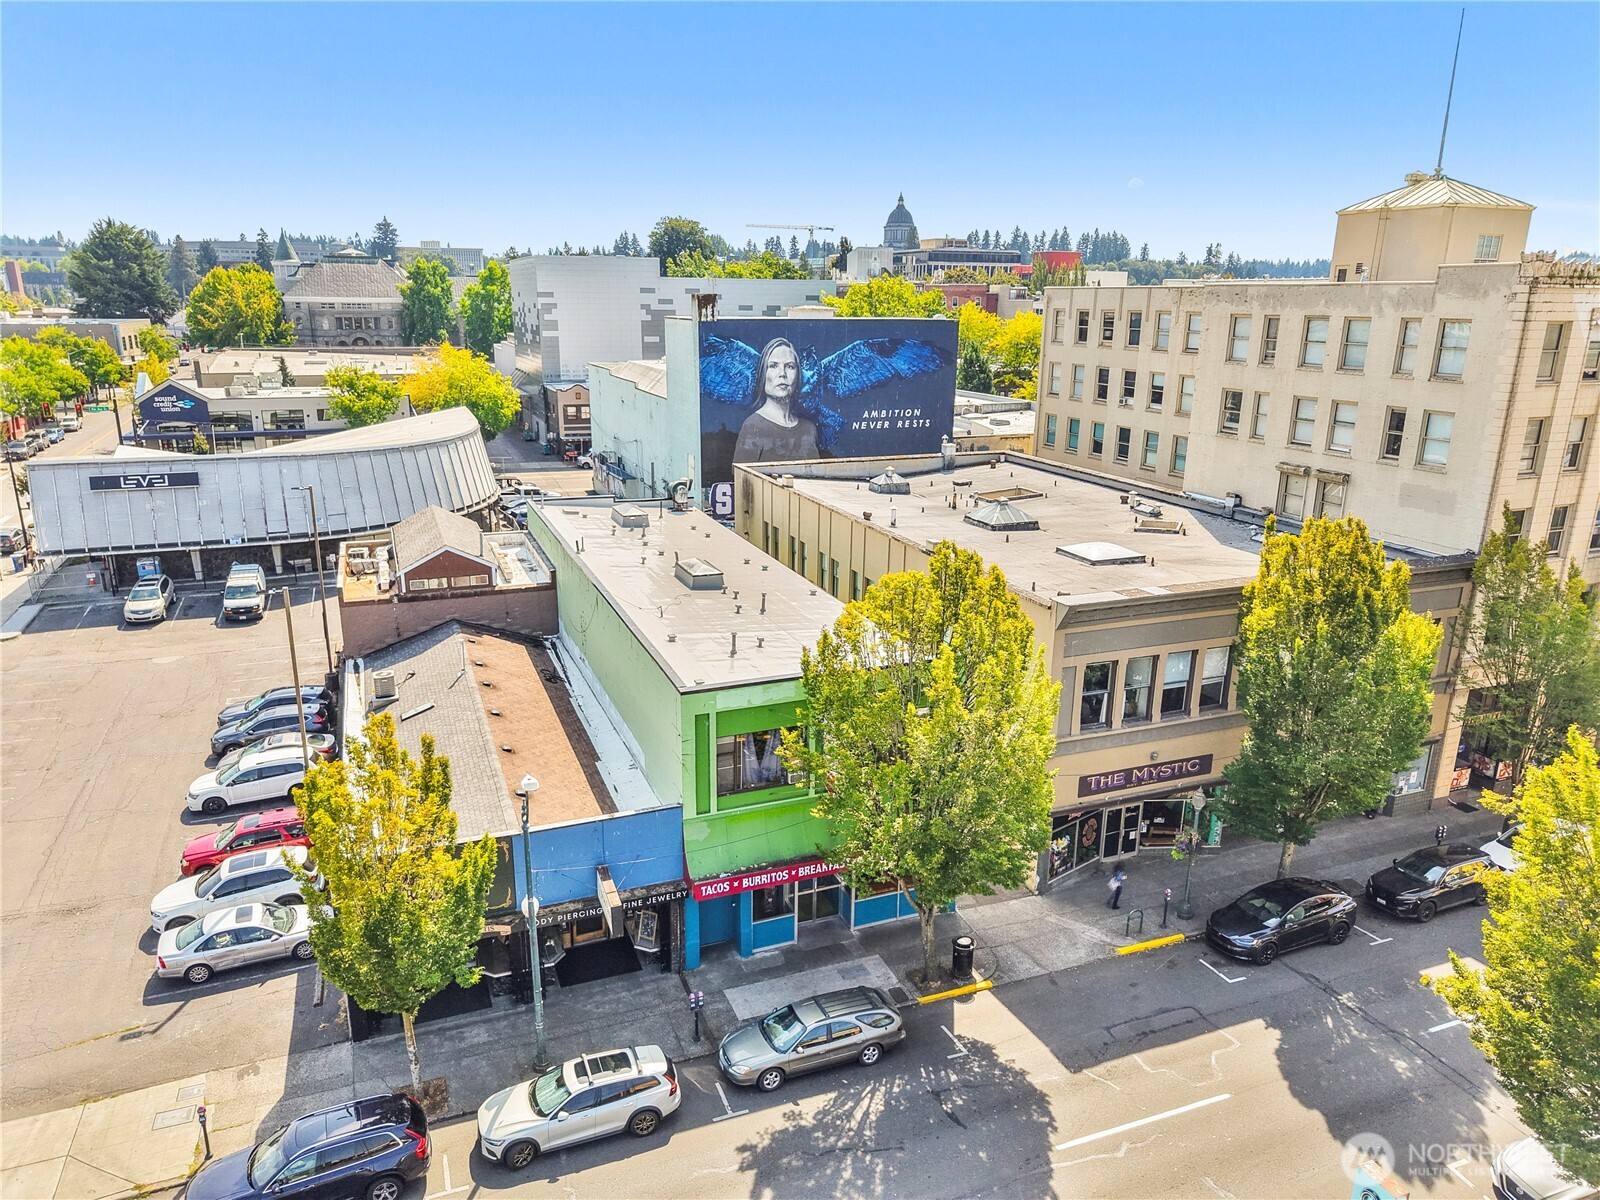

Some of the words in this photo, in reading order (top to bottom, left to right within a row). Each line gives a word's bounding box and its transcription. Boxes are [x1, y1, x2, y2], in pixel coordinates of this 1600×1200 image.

[862, 408, 921, 419] AMBITION
[852, 421, 890, 430] NEVER
[897, 419, 931, 429] RESTS
[120, 475, 169, 488] LEVEL
[1087, 773, 1125, 791] THE
[1132, 759, 1200, 783] MYSTIC
[701, 881, 730, 897] TACOS
[742, 870, 789, 888] BURRITOS
[558, 907, 604, 922] PIERCING
[622, 899, 643, 910] FINE
[646, 890, 688, 904] JEWELRY
